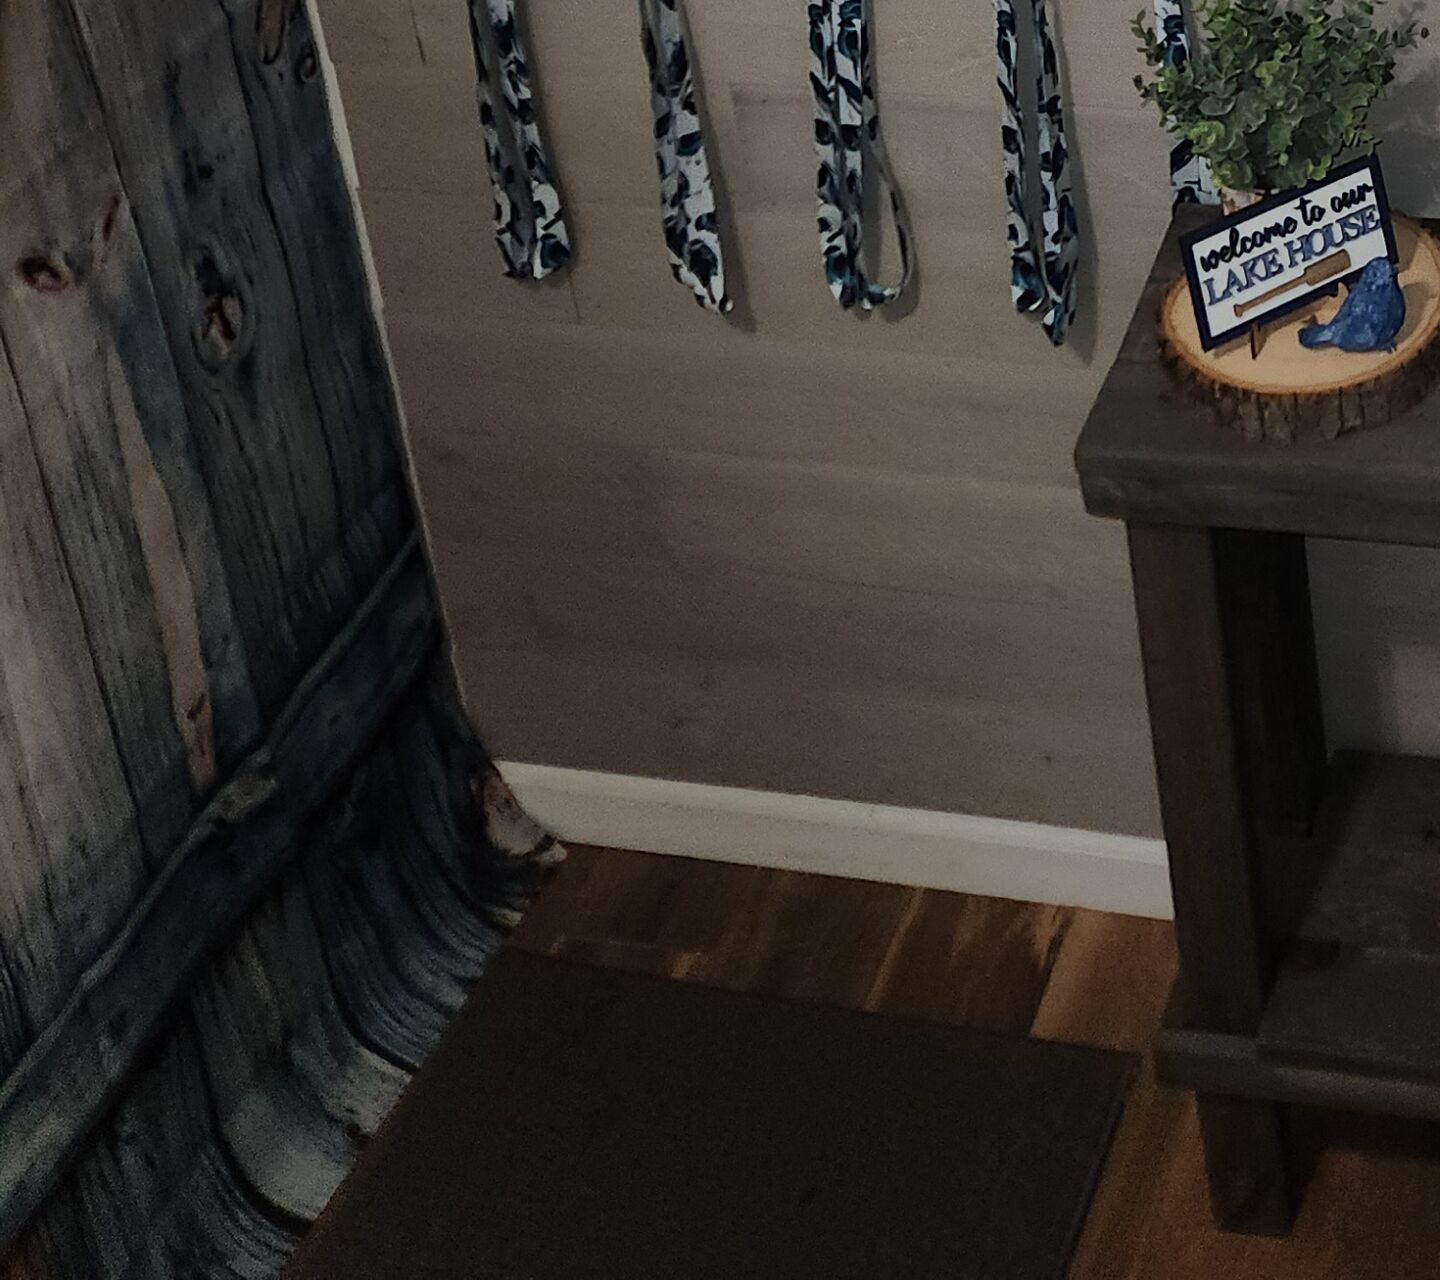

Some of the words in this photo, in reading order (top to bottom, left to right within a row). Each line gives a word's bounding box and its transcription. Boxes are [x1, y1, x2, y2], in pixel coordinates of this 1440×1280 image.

[1200, 215, 1298, 273] welcome
[1294, 197, 1327, 227] to
[1330, 182, 1375, 214] our
[1203, 247, 1284, 307] LAKE
[1287, 203, 1382, 269] HOUSE
